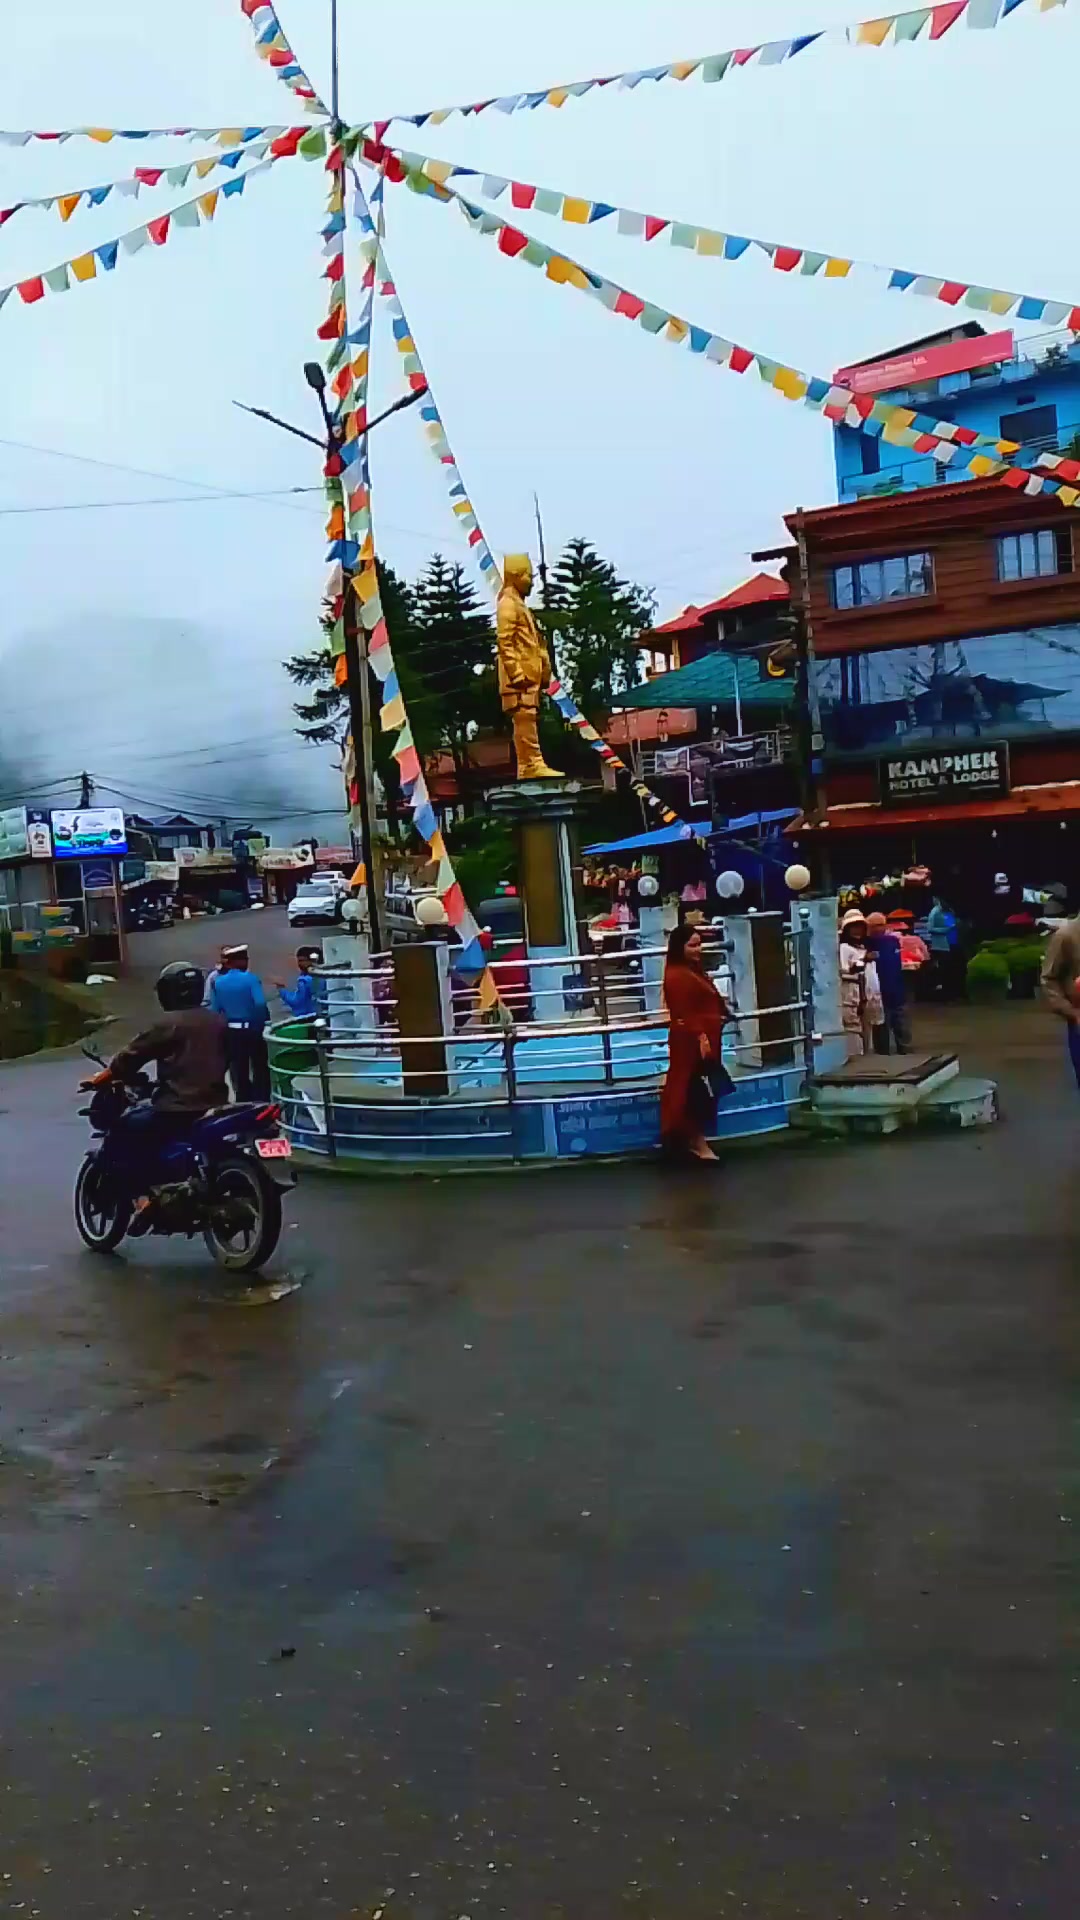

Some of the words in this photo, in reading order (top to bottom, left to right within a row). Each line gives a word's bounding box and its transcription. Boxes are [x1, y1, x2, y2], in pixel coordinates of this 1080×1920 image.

[888, 751, 998, 778] KAMPHEK
[889, 777, 935, 790] HOTEL
[953, 769, 999, 784] LODGE
